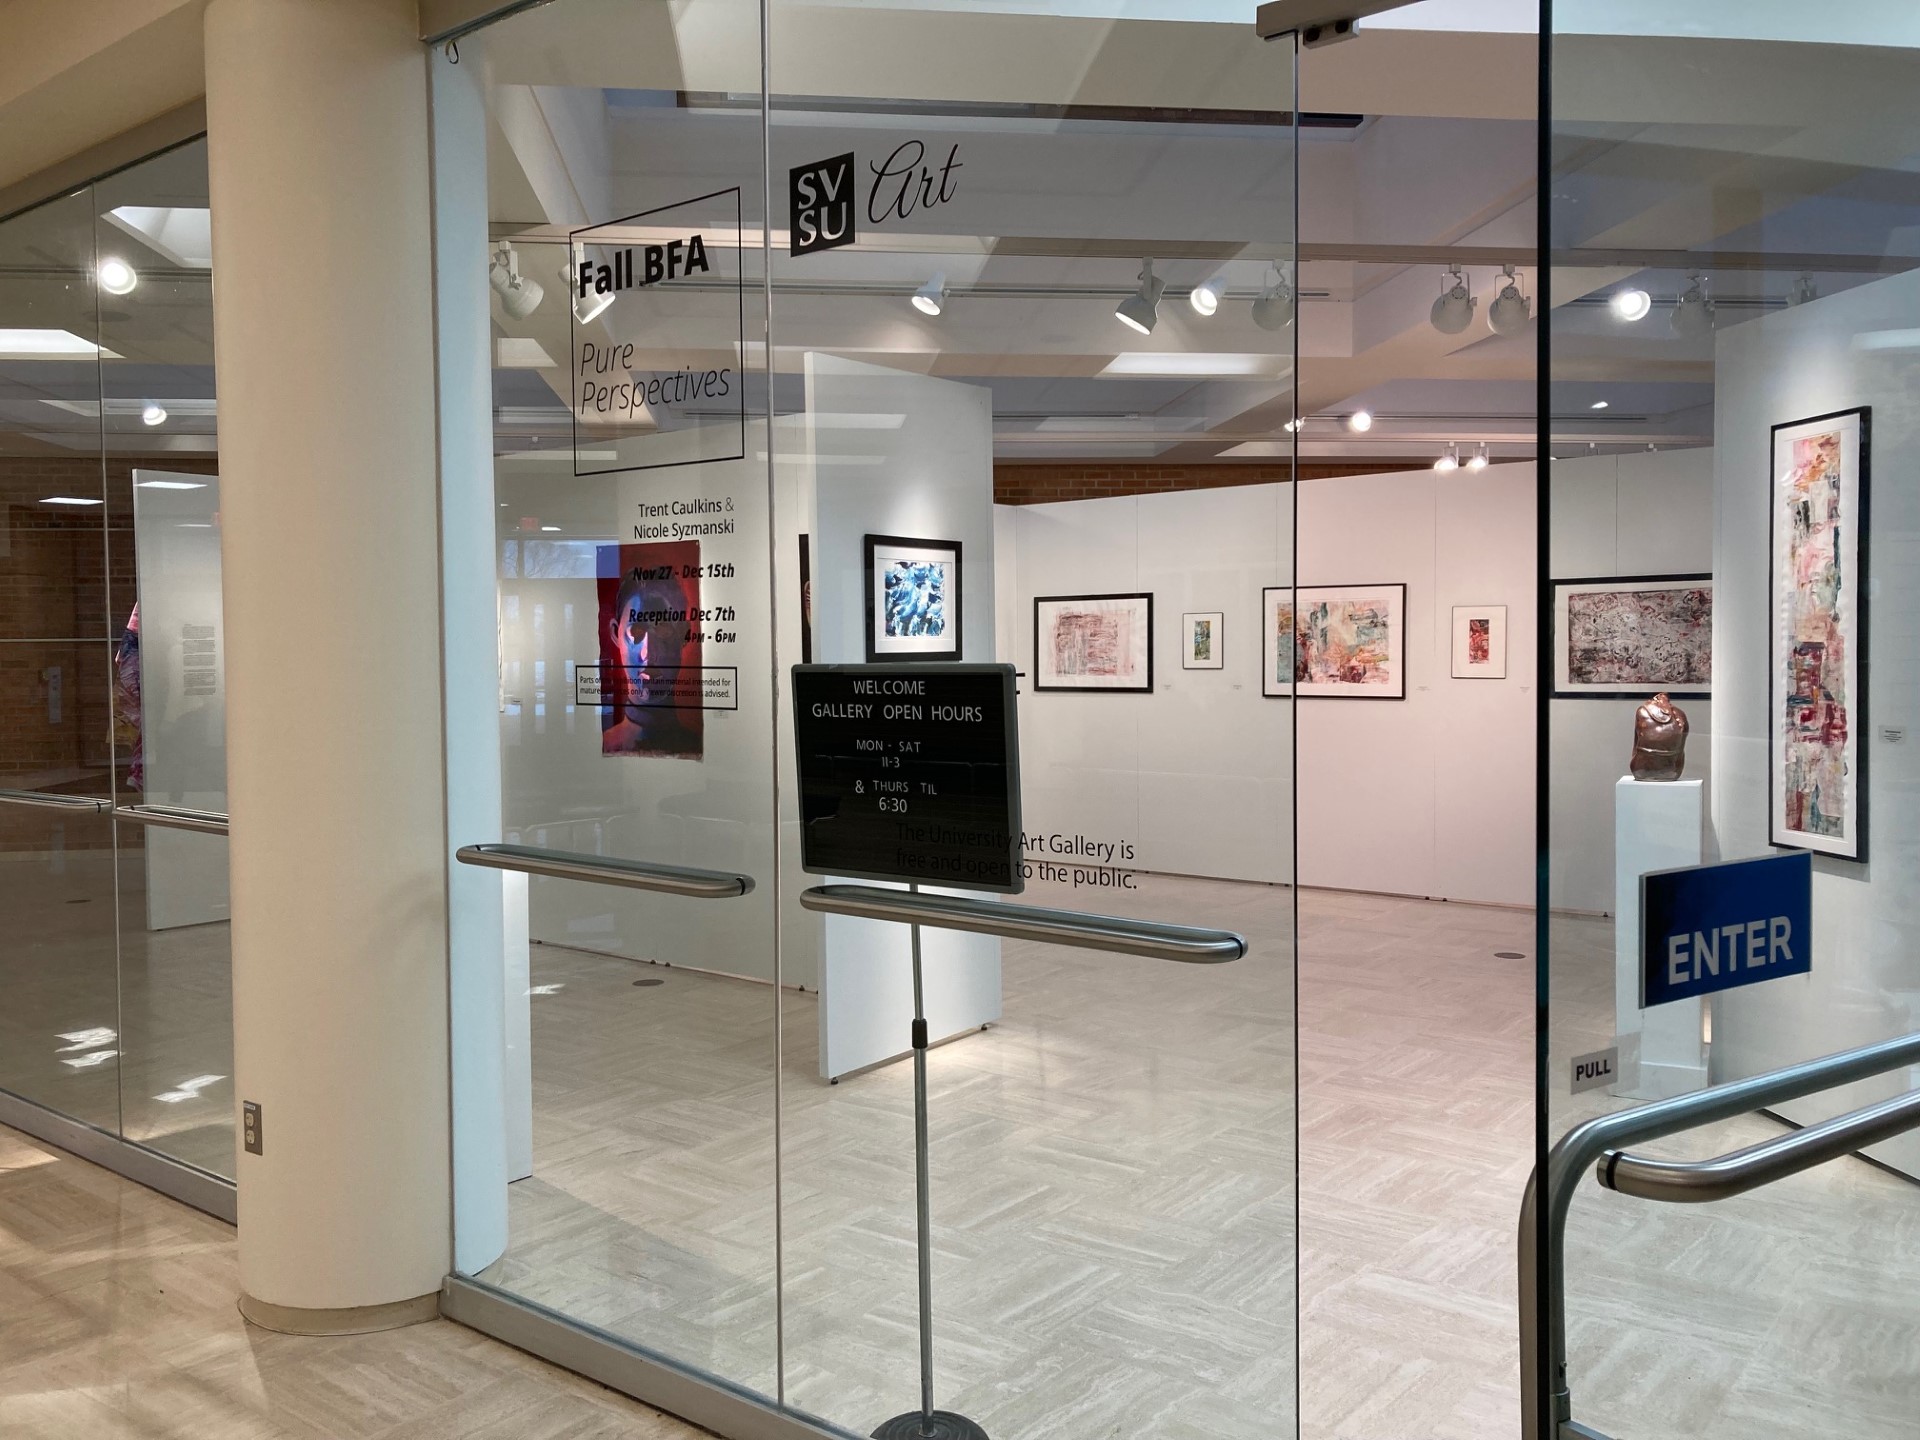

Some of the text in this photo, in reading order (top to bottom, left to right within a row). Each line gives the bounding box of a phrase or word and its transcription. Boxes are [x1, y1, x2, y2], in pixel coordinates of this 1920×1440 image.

[867, 140, 964, 224] Art
[578, 235, 710, 300] Fall BFA
[580, 342, 635, 377] Pure
[581, 365, 732, 419] Perspectives
[637, 497, 735, 518] Trent Caulkins &
[633, 519, 734, 541] Nicole Syzmanski
[632, 567, 656, 581] Nov
[658, 566, 673, 580] 27
[682, 564, 704, 579] Dec
[707, 563, 735, 578] 15th
[629, 606, 735, 625] Reception Dec 7th
[684, 629, 705, 643] 4PM
[715, 629, 737, 643] 6PM
[579, 676, 594, 684] Parts
[721, 678, 732, 686] for
[853, 680, 926, 695] WELCOME
[812, 703, 983, 722] GALLERY OPEN HOURS
[856, 739, 884, 751] MON
[898, 741, 921, 753] SAT
[855, 779, 937, 795] & THURS TIL
[878, 796, 908, 813] 6:30
[895, 822, 1135, 863] The University Art Gallery is
[895, 847, 1138, 890] free and open to the public.
[1668, 915, 1794, 986] ENTER
[1575, 1059, 1612, 1082] PULL
